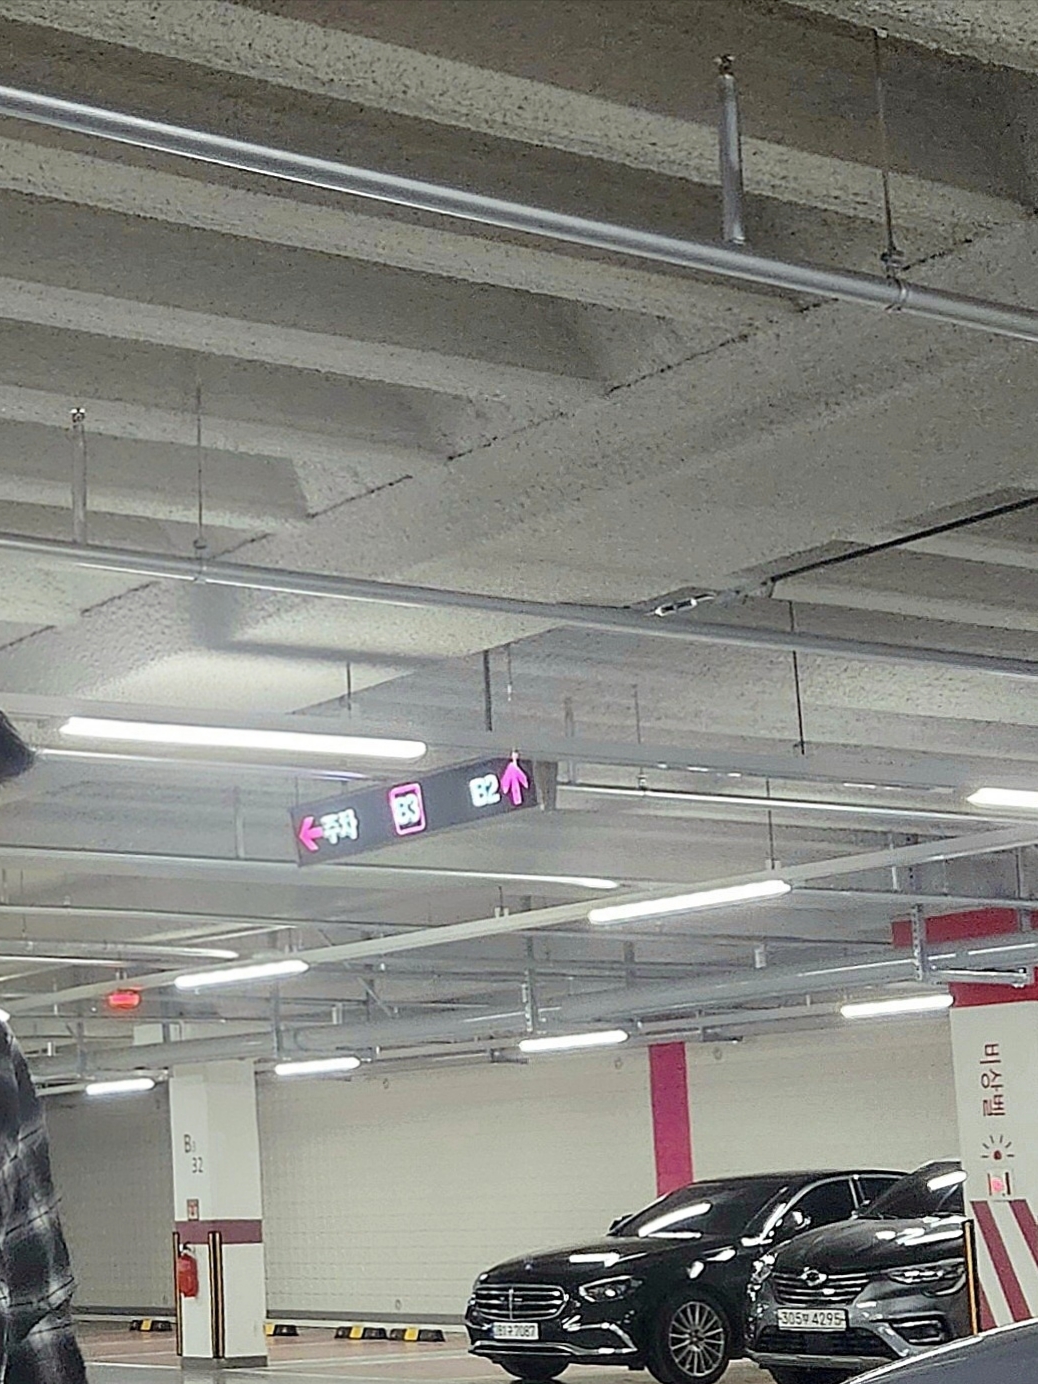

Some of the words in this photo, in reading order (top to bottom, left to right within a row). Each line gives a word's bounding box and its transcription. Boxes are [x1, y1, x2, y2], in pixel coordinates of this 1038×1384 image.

[469, 773, 501, 807] B2
[979, 1043, 1006, 1117] 비상벨
[191, 1156, 204, 1174] 32
[811, 1311, 842, 1326] 4295
